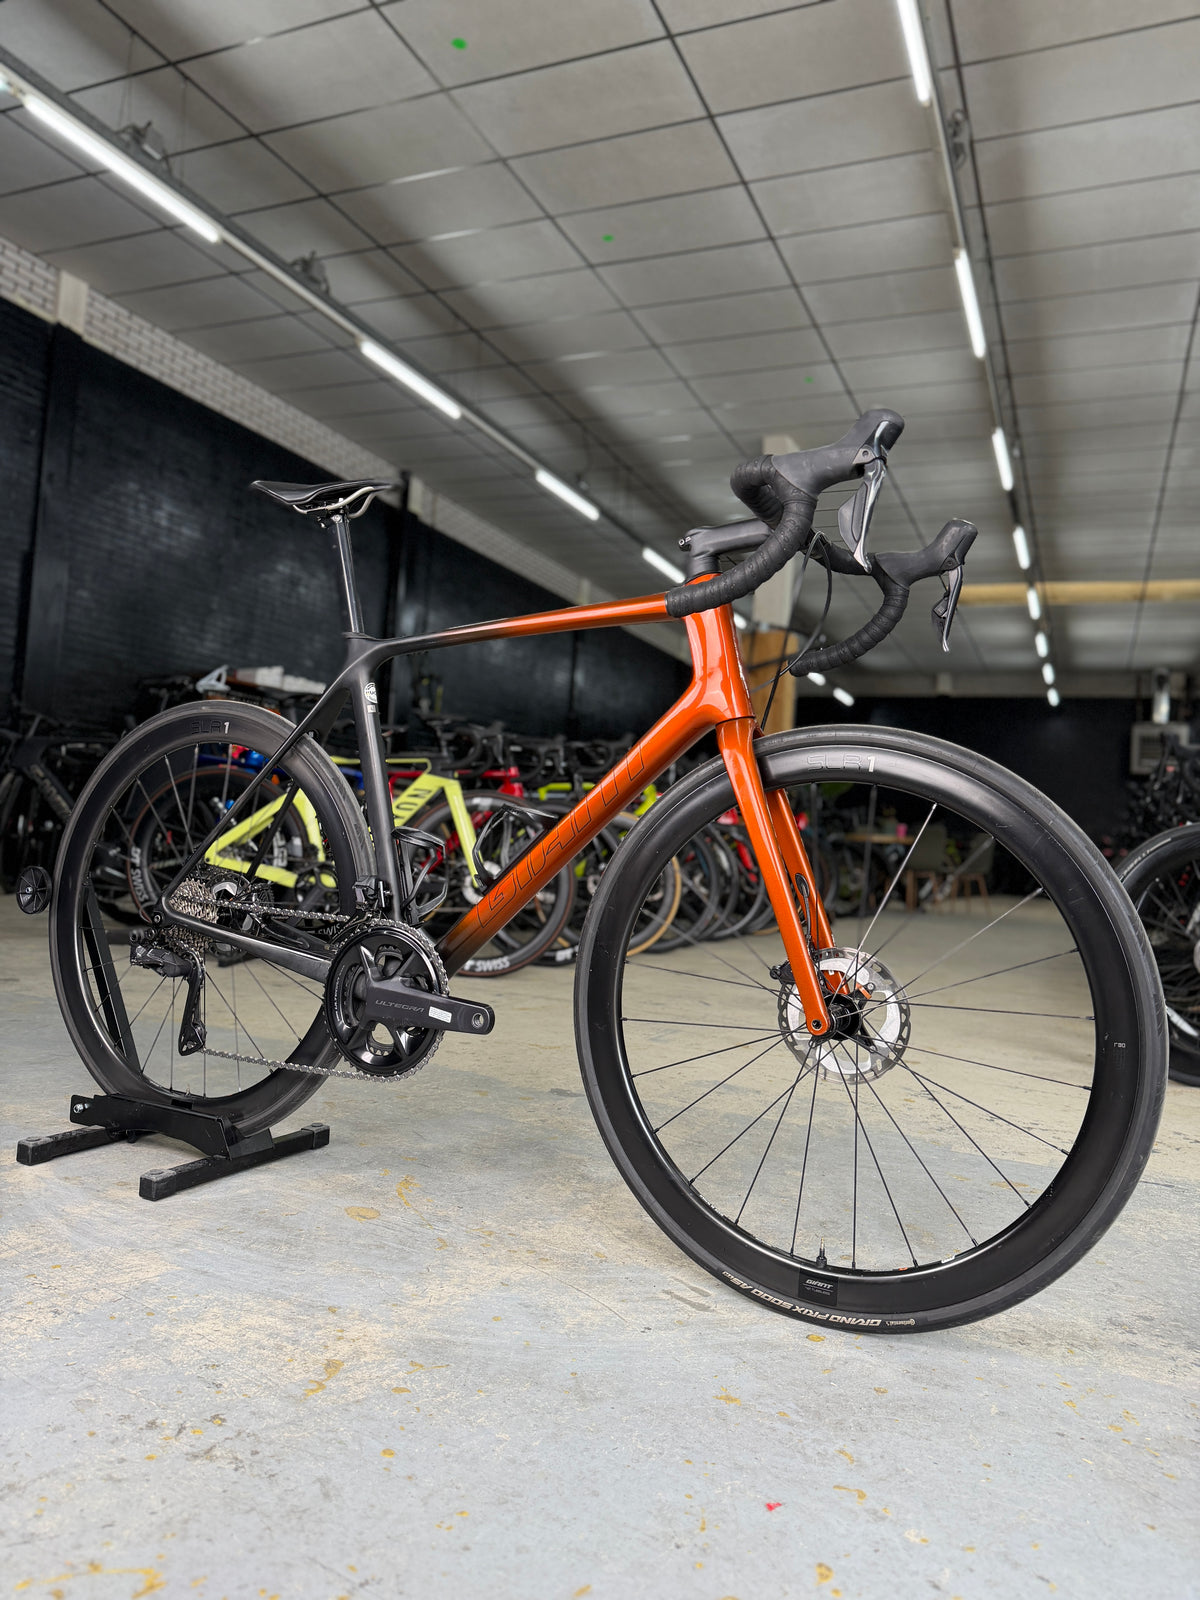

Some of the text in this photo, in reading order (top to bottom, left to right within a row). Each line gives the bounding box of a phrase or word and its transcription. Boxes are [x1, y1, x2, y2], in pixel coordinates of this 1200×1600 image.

[375, 999, 425, 1013] ULTEGRA
[750, 1288, 794, 1310] 5000
[792, 1305, 830, 1321] PRIX
[829, 1314, 882, 1327] GRAND
